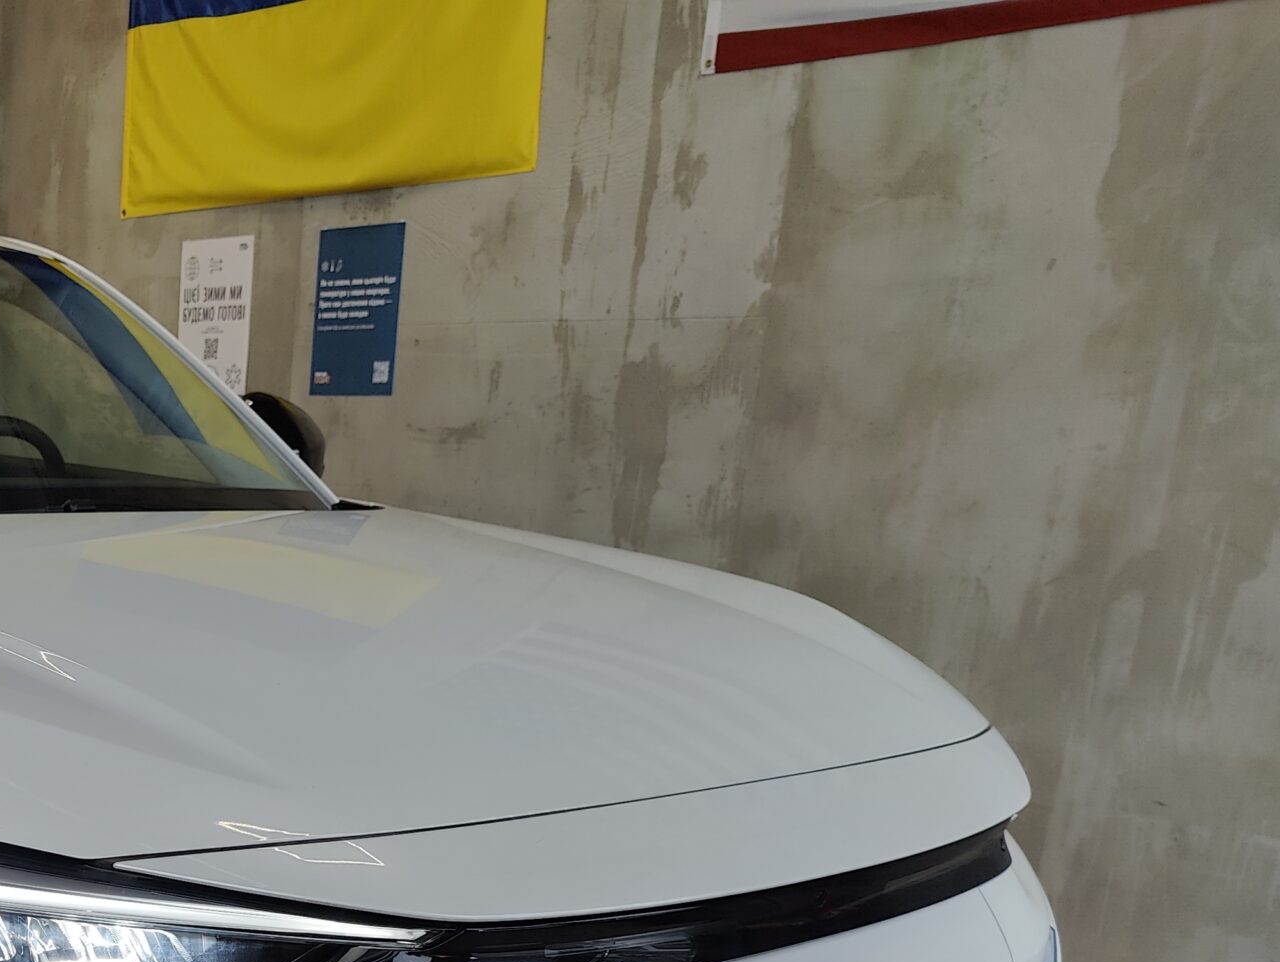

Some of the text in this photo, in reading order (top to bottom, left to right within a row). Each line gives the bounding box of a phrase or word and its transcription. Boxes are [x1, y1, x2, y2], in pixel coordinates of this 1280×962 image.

[203, 286, 226, 303] ЗИМИ
[230, 285, 243, 300] МИ
[183, 304, 246, 324] БУДЕМО ГОТОВІ
